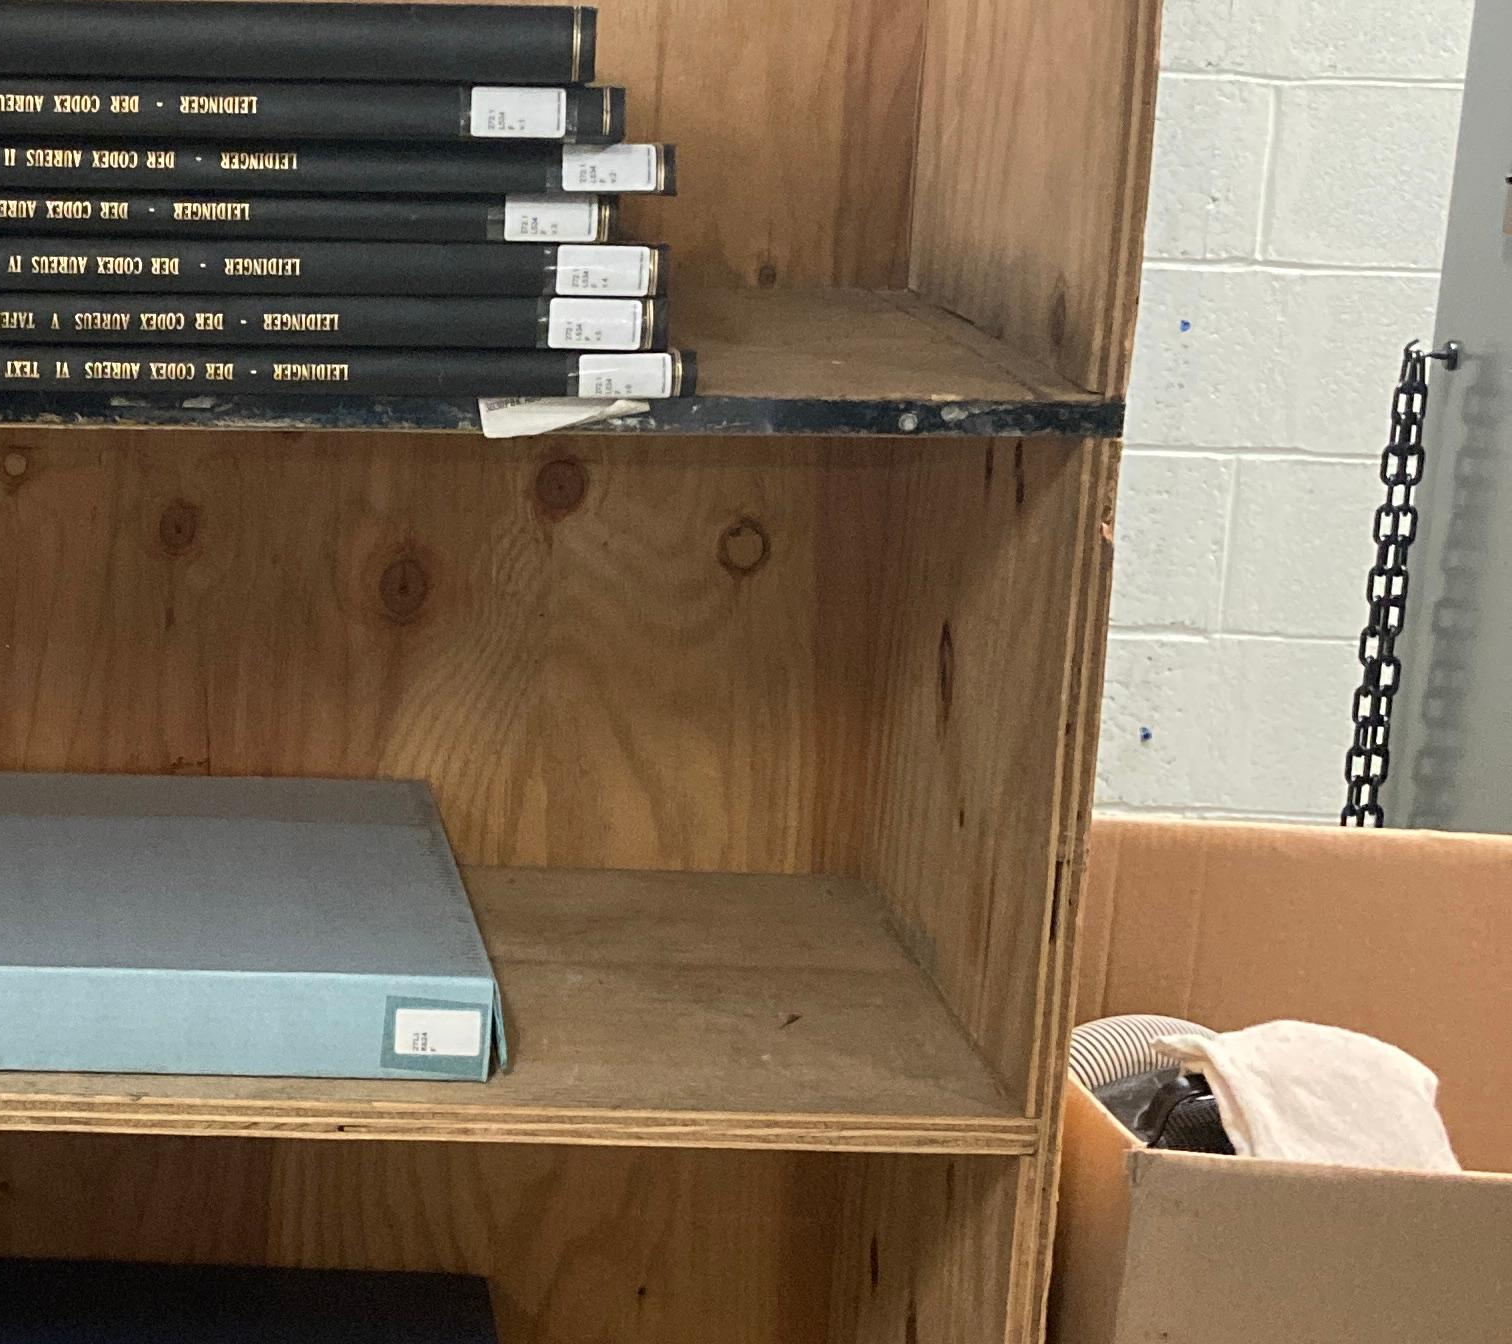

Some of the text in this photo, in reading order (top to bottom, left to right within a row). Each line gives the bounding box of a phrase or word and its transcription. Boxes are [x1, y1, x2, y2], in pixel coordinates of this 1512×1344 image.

[53, 95, 100, 113] CODEX
[111, 95, 139, 113] DER
[180, 96, 257, 113] LEIDINGER
[4, 149, 16, 167] II
[26, 150, 82, 167] AUREUS
[92, 151, 138, 168] CODEX
[147, 151, 175, 169] DER
[220, 152, 297, 169] LEIDINGER
[46, 201, 91, 218] CODEX
[100, 202, 128, 219] DER
[174, 202, 250, 220] LEIDINGER
[7, 256, 22, 273] IV
[31, 256, 87, 273] AUREUS
[96, 257, 142, 274] CODEX
[151, 257, 179, 275] DER
[224, 258, 300, 275] LEIDINGER
[51, 312, 58, 329] V
[75, 312, 130, 329] AUREUS
[140, 312, 184, 330] CODEX
[195, 313, 223, 330] DER
[263, 314, 339, 330] LEIDINGER
[5, 361, 40, 378] TEXT
[56, 361, 69, 379] VI
[85, 362, 140, 379] AUREUS
[150, 362, 195, 379] CODEX
[205, 363, 233, 380] DER
[273, 363, 348, 381] LEIDINGER
